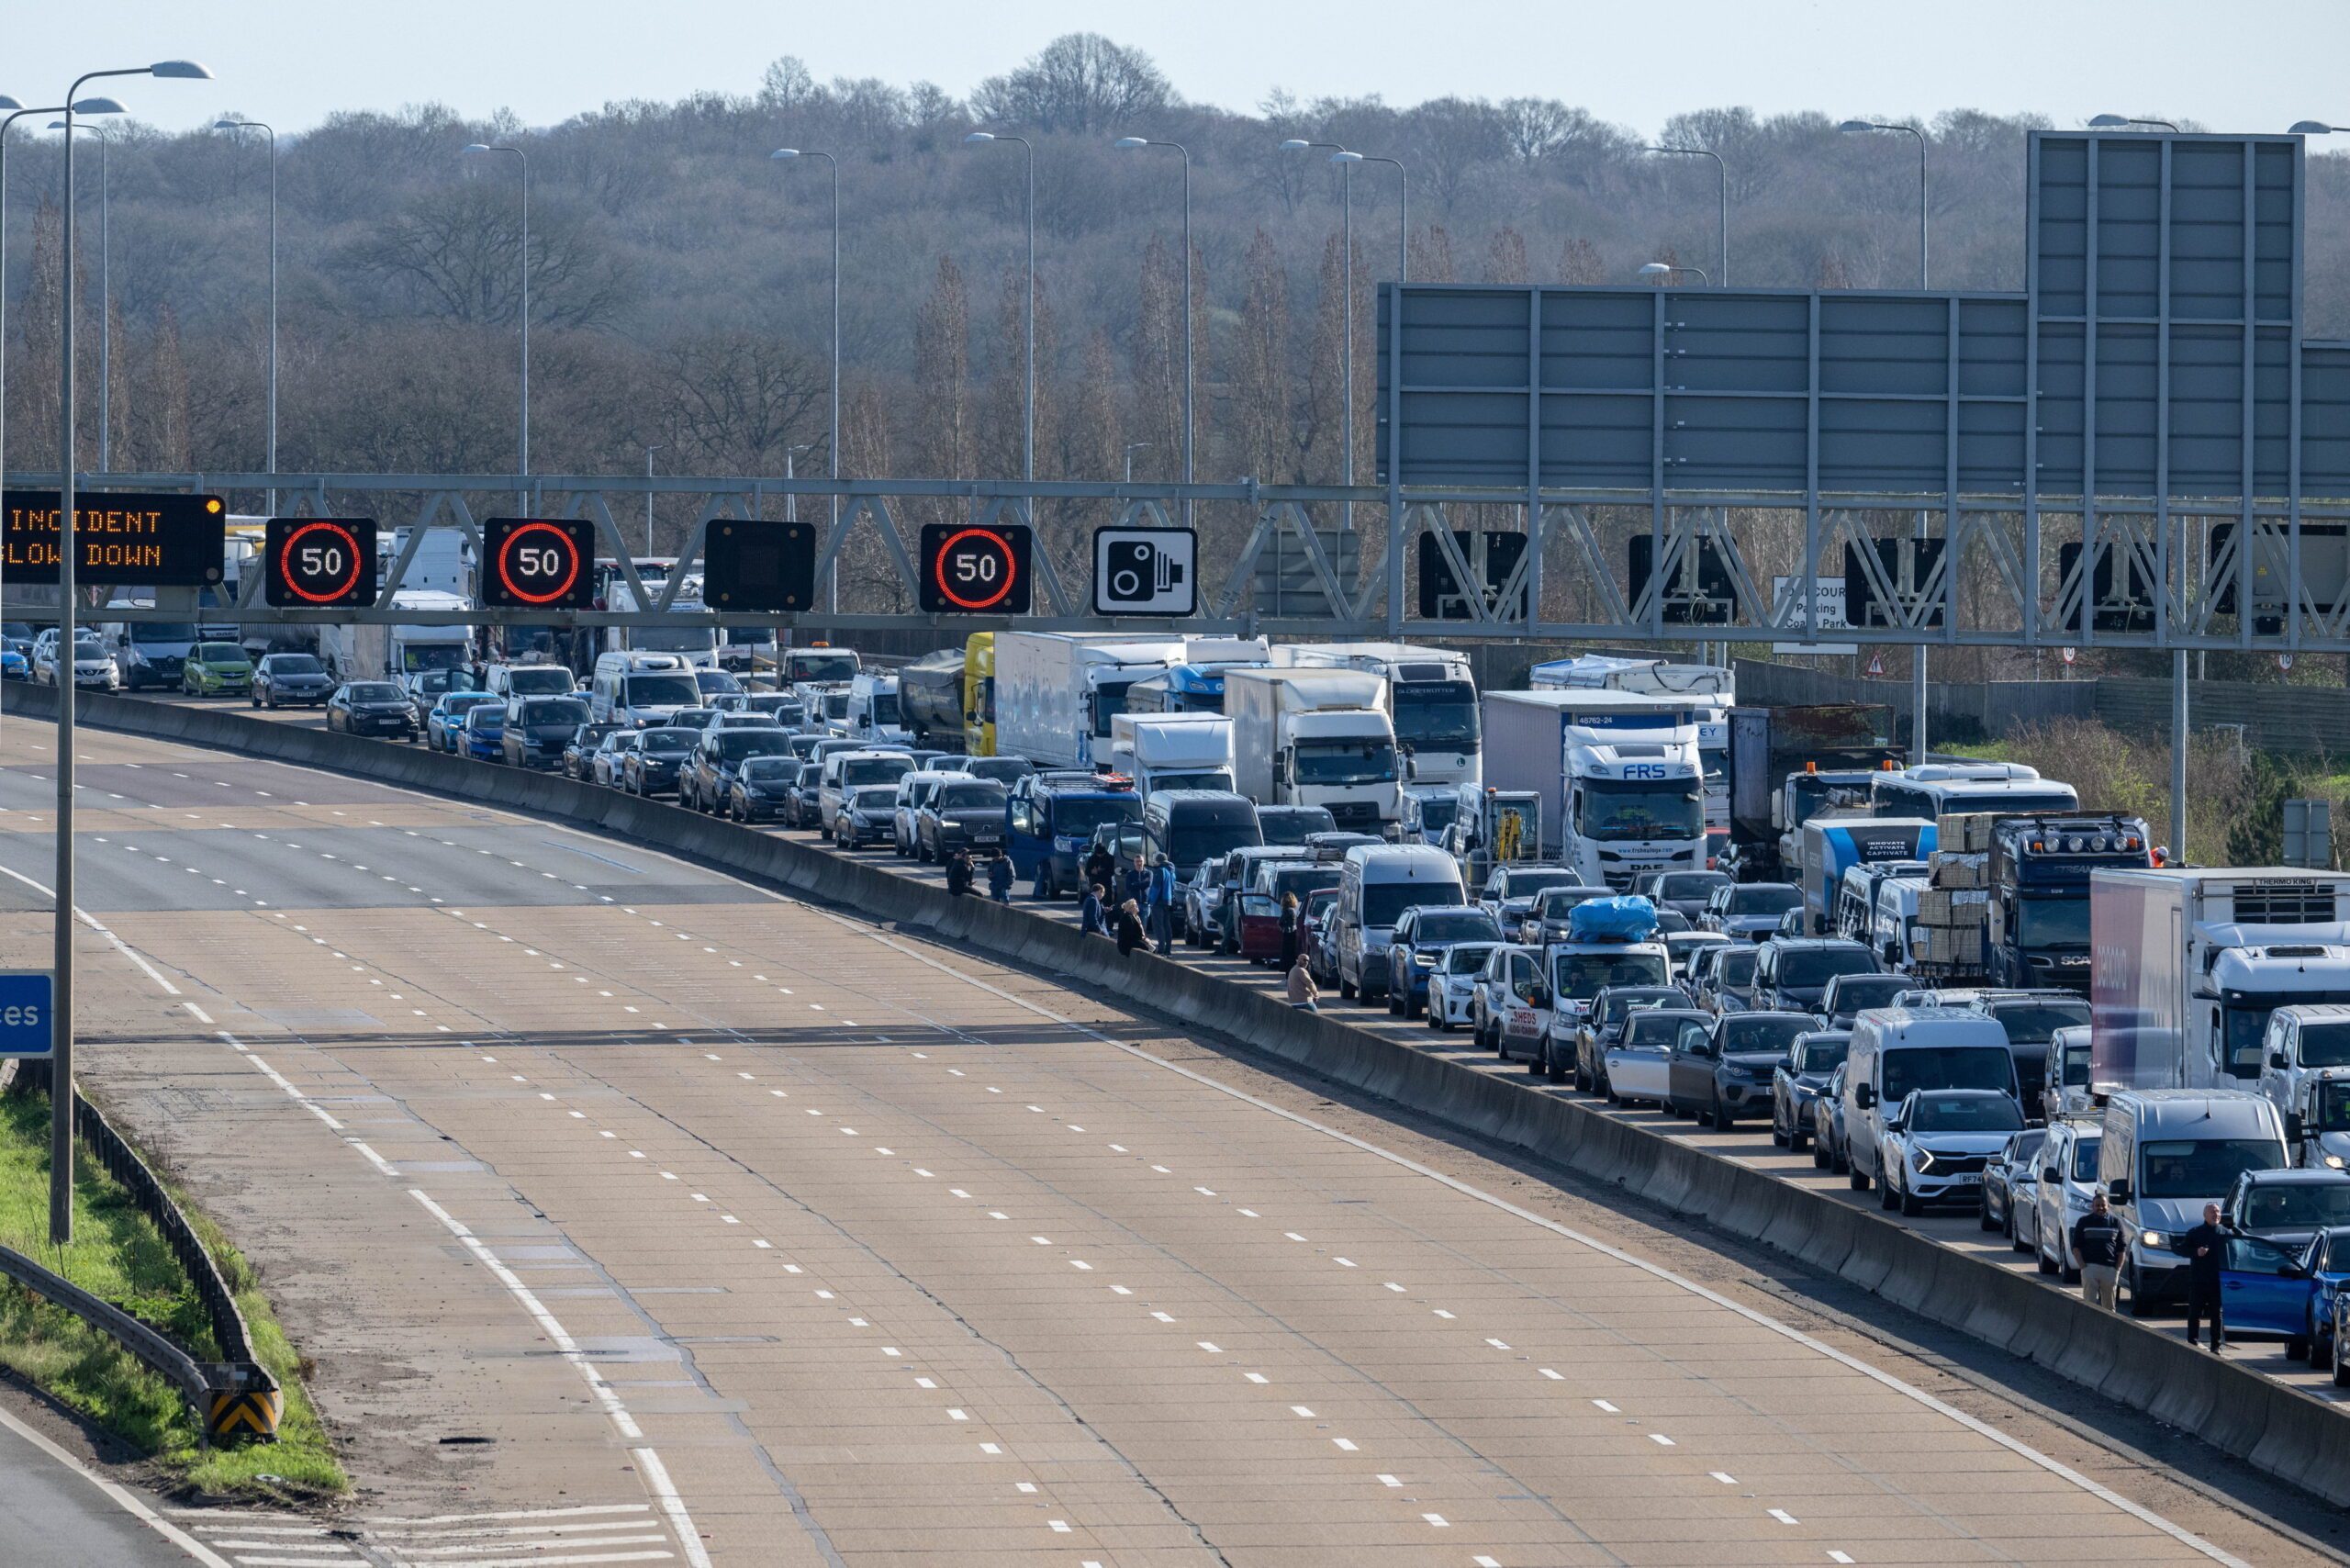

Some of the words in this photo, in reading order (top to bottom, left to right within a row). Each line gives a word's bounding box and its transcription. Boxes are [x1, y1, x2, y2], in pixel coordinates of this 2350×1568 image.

[12, 510, 161, 532] INCIDENT
[0, 543, 62, 564] LOW
[87, 544, 160, 566] DOWN
[302, 548, 341, 576] 50
[520, 548, 559, 576] 50
[957, 554, 996, 581] 50
[1796, 603, 1836, 616] Paking
[1785, 618, 1818, 628] Coa
[1823, 618, 1847, 628] Park
[2281, 654, 2291, 665] 10
[1579, 716, 1613, 724] 48762-24
[1699, 727, 1717, 736] EY
[1623, 764, 1666, 779] FRS
[2060, 956, 2092, 965] SCA
[0, 1005, 39, 1026] es
[1513, 1011, 1537, 1025] SHEDS
[1962, 1175, 1982, 1183] RF74
